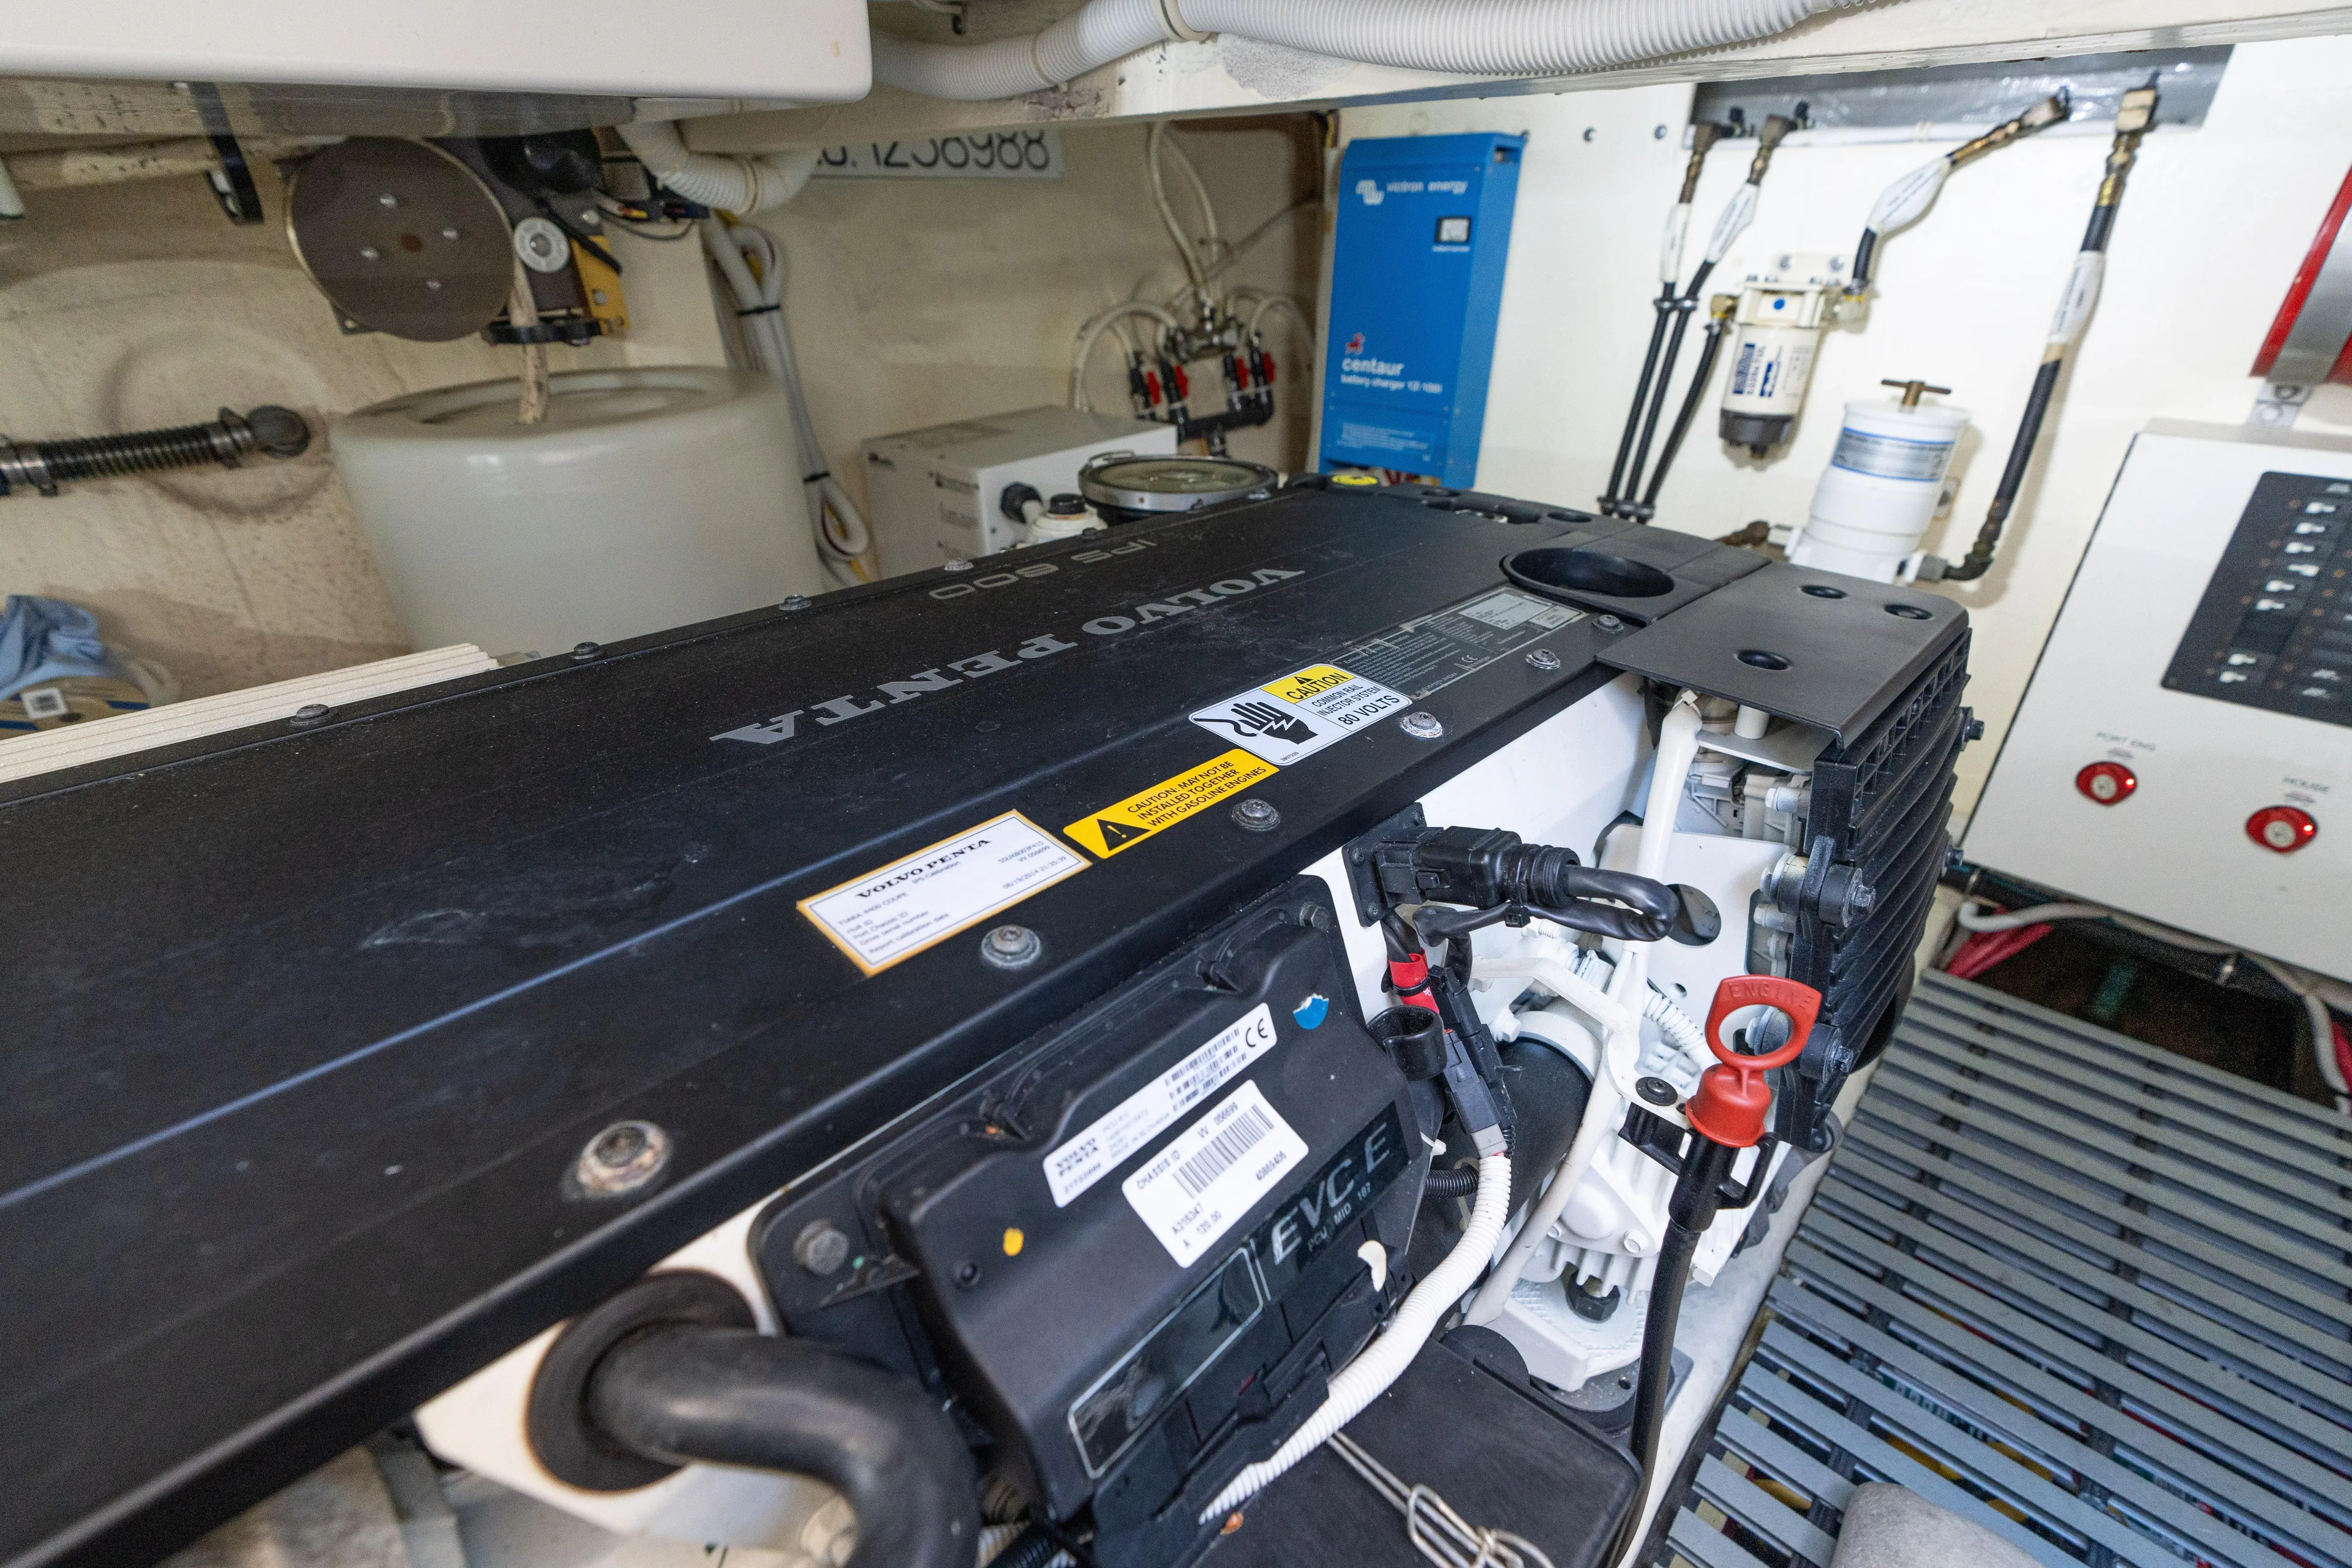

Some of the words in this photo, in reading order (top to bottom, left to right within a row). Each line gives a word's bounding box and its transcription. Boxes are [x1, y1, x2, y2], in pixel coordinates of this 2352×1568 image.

[1342, 357, 1404, 376] centaur
[1082, 568, 1305, 635] VOLVO
[710, 633, 1077, 744] PENTA
[1286, 673, 1349, 699] CAUTION
[1311, 690, 1347, 707] COMMON
[1344, 684, 1363, 693] RAIL
[1317, 698, 1355, 716] INJECTOR
[1351, 686, 1383, 701] SYSTEM
[1338, 714, 1360, 725] 80
[1353, 695, 1400, 716] VOLTS
[1127, 788, 1180, 813] CAUTION:
[1178, 776, 1200, 790] MAY
[1199, 767, 1221, 780] NOT
[1219, 761, 1234, 769] BE
[1137, 793, 1190, 820] INSTALLED
[1188, 769, 1240, 794] TOGETHER
[1148, 810, 1178, 827] WITH
[1176, 786, 1227, 813] GASOLINE
[1225, 767, 1267, 790] ENGINES
[856, 868, 923, 898] VOLVO
[925, 839, 992, 868] PENTA
[1246, 1017, 1268, 1047] CE
[1365, 1122, 1390, 1174] E
[1333, 1202, 1352, 1225] MID
